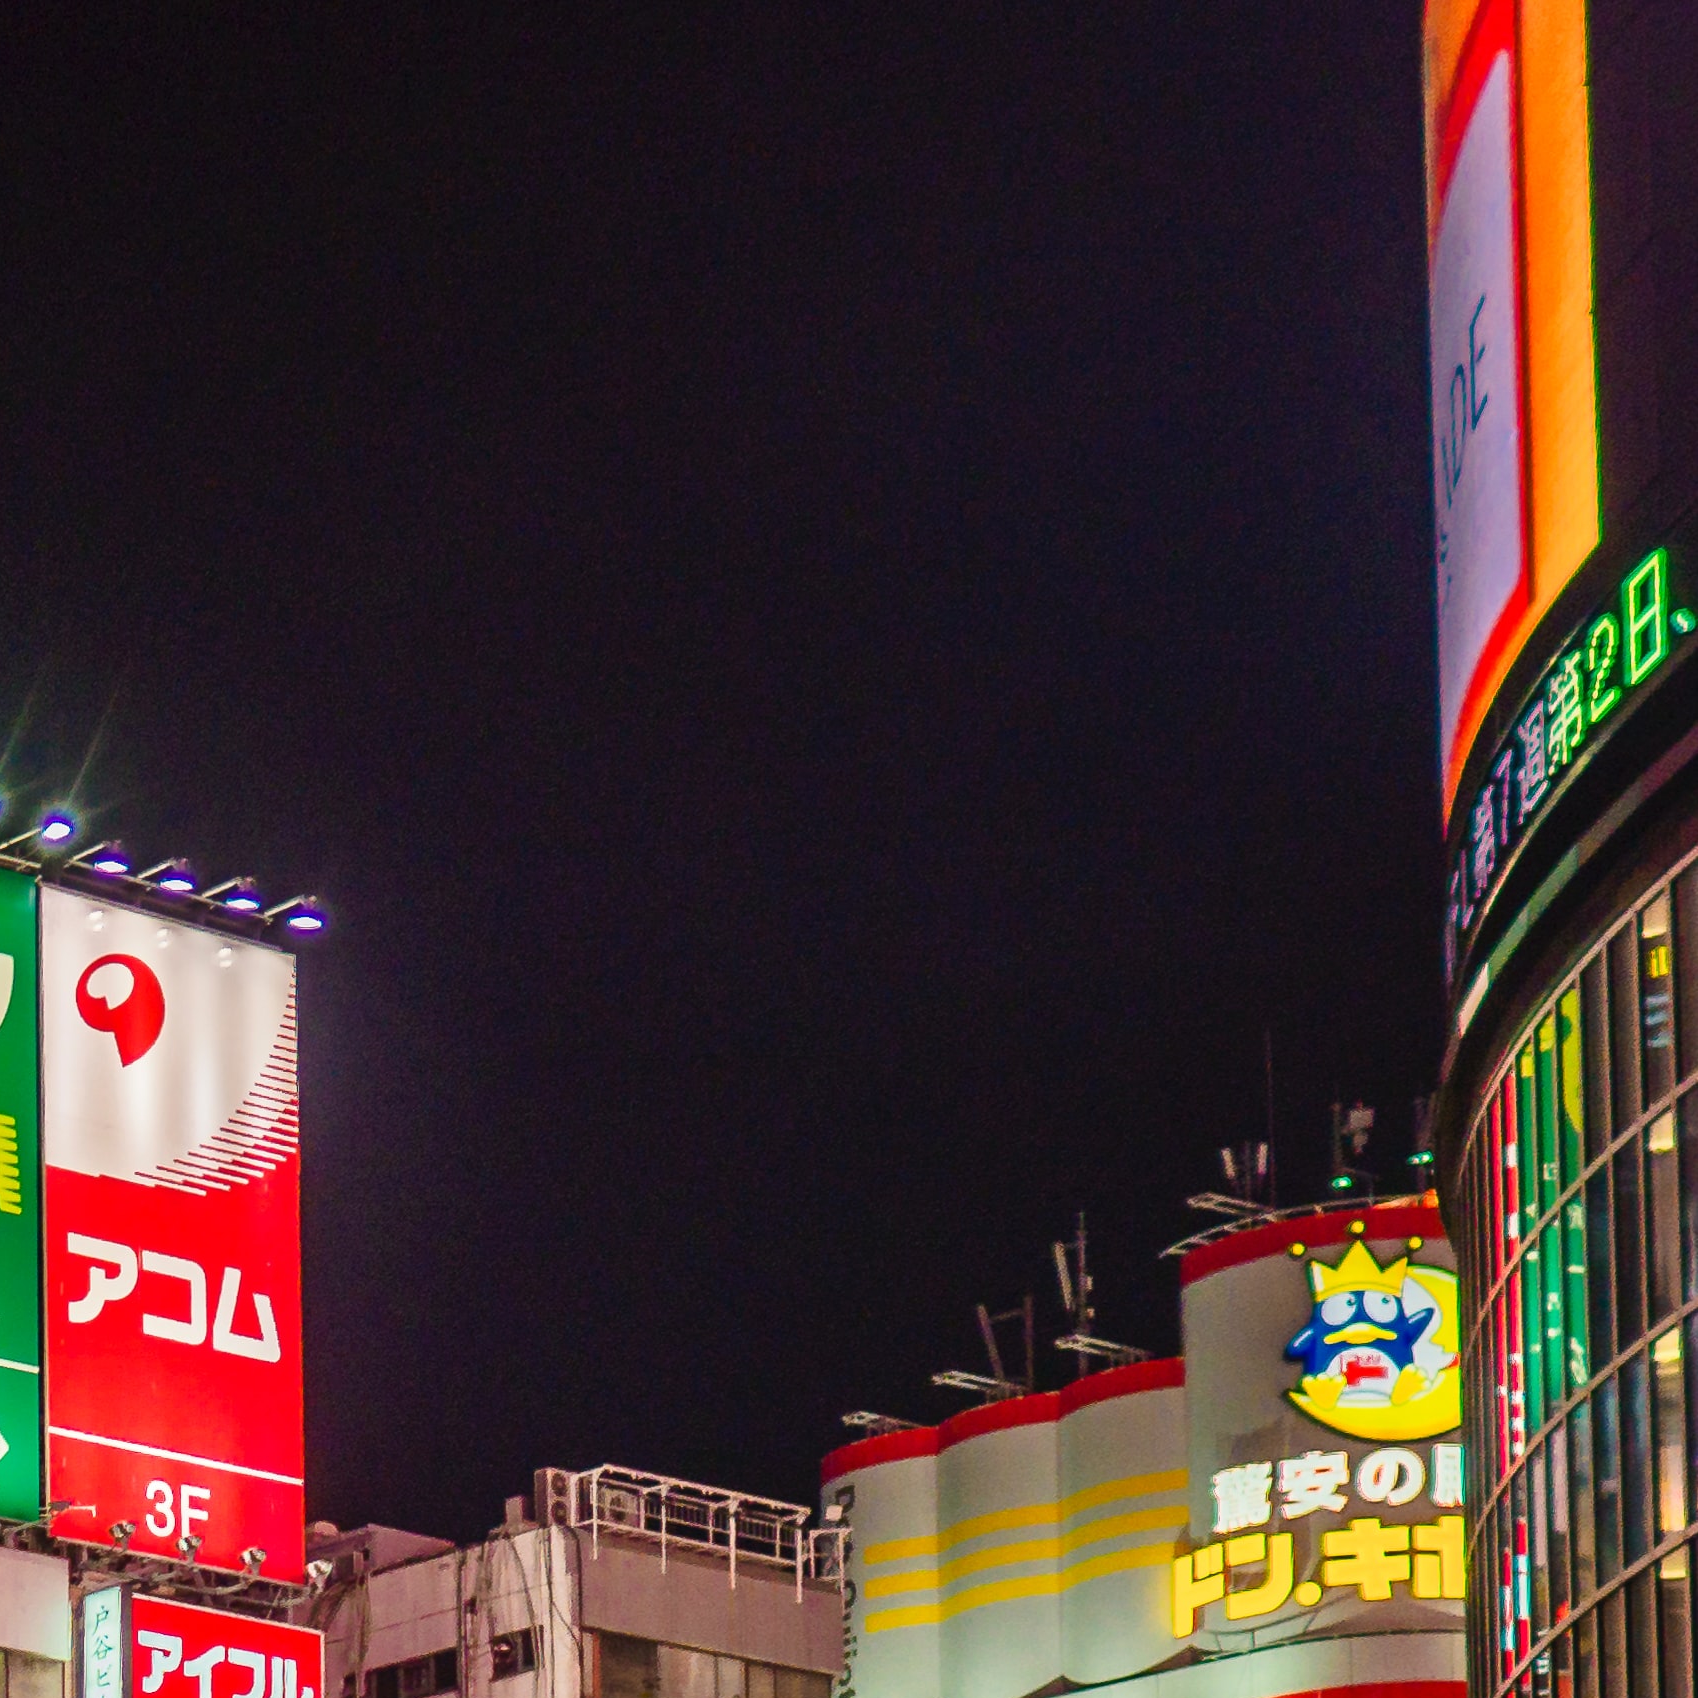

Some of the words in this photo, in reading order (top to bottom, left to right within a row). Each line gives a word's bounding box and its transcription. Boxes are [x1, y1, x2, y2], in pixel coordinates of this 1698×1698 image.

[66, 1230, 282, 1364] アコム
[144, 1477, 211, 1539] 3F
